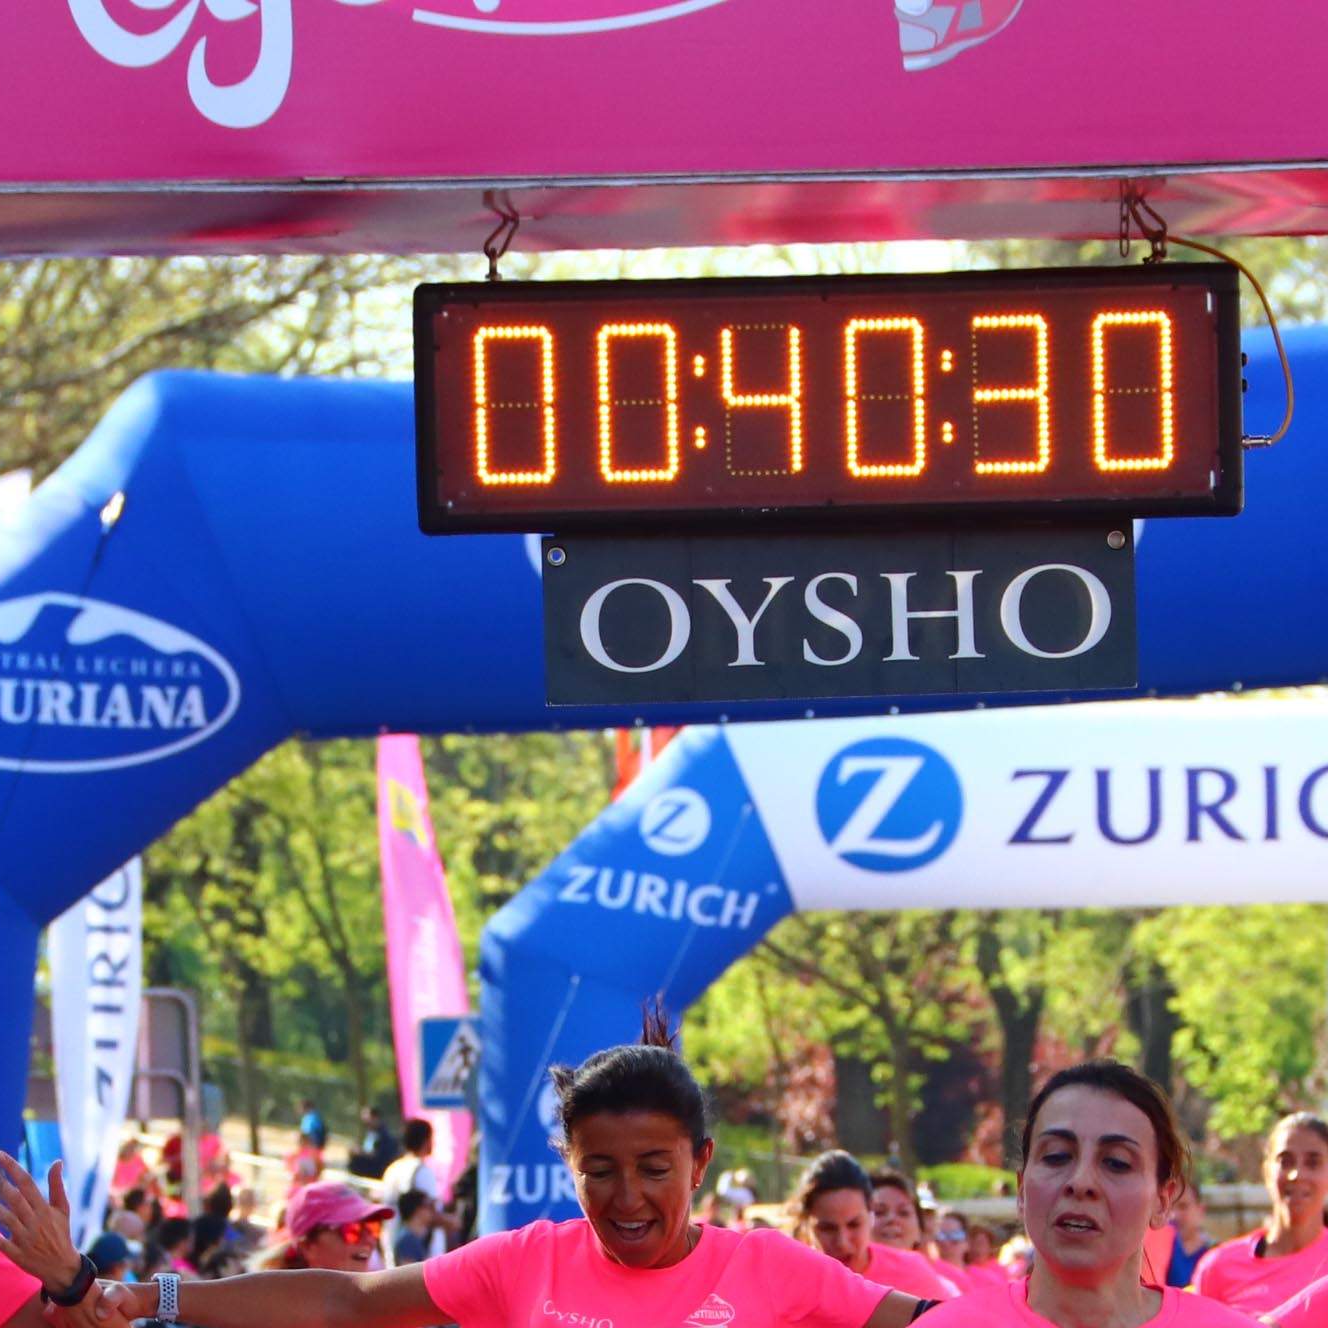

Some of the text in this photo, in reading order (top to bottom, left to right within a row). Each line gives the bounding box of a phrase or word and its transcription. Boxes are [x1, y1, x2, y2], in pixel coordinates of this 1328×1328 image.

[472, 311, 1175, 485] 00:40:30
[579, 563, 1112, 673] OYSHO
[74, 653, 204, 677] LECHERA
[559, 865, 760, 930] ZURICH
